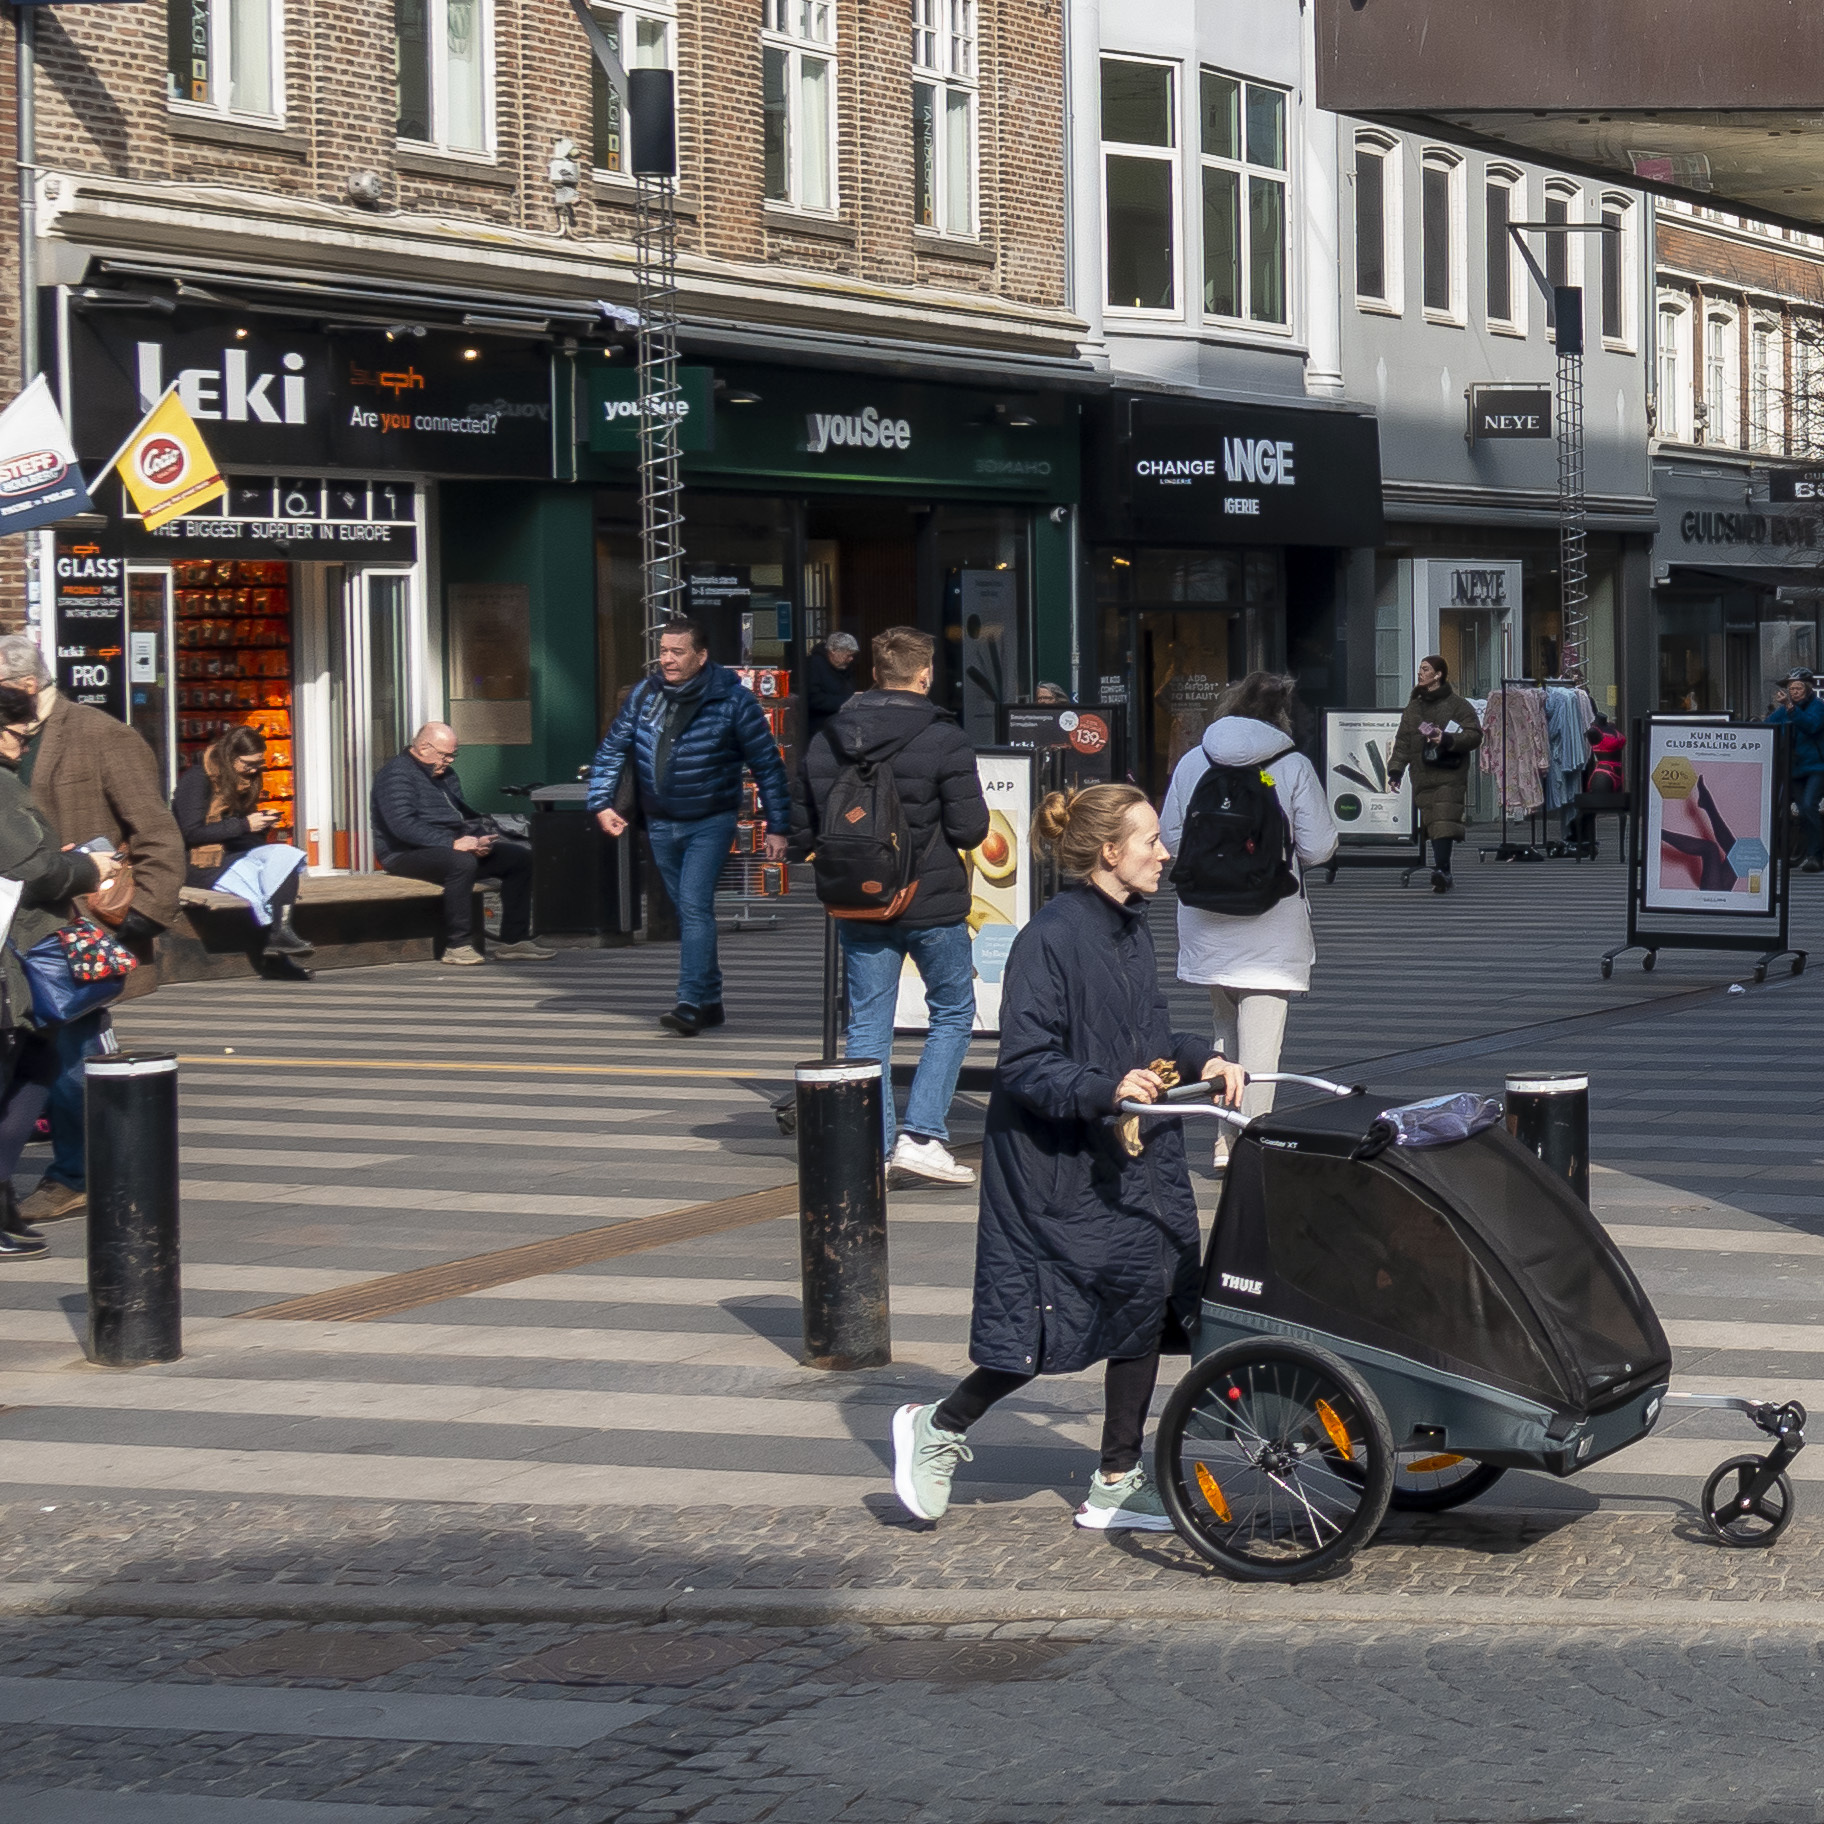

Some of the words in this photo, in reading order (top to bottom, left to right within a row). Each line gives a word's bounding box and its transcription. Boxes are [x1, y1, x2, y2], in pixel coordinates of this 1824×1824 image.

[350, 405, 378, 428] Are
[380, 410, 411, 434] you
[414, 412, 500, 435] connected?
[812, 405, 912, 454] youSee
[1484, 415, 1540, 430] NEYE
[1136, 460, 1216, 476] CHANGE
[186, 520, 244, 540] BIGGEST
[251, 522, 315, 540] SUPPLIER
[319, 524, 334, 540] IN
[339, 524, 393, 542] EUROPE
[57, 557, 120, 578] GLASS
[1450, 568, 1507, 600] NEYE
[72, 664, 108, 687] PRO
[1665, 739, 1738, 751] CLUBSALLING
[1740, 742, 1762, 752] APP
[1689, 731, 1712, 741] KUN
[1715, 732, 1738, 742] MED
[1660, 768, 1689, 781] 20%
[985, 780, 1015, 792] APP
[1221, 1272, 1264, 1296] THULE
